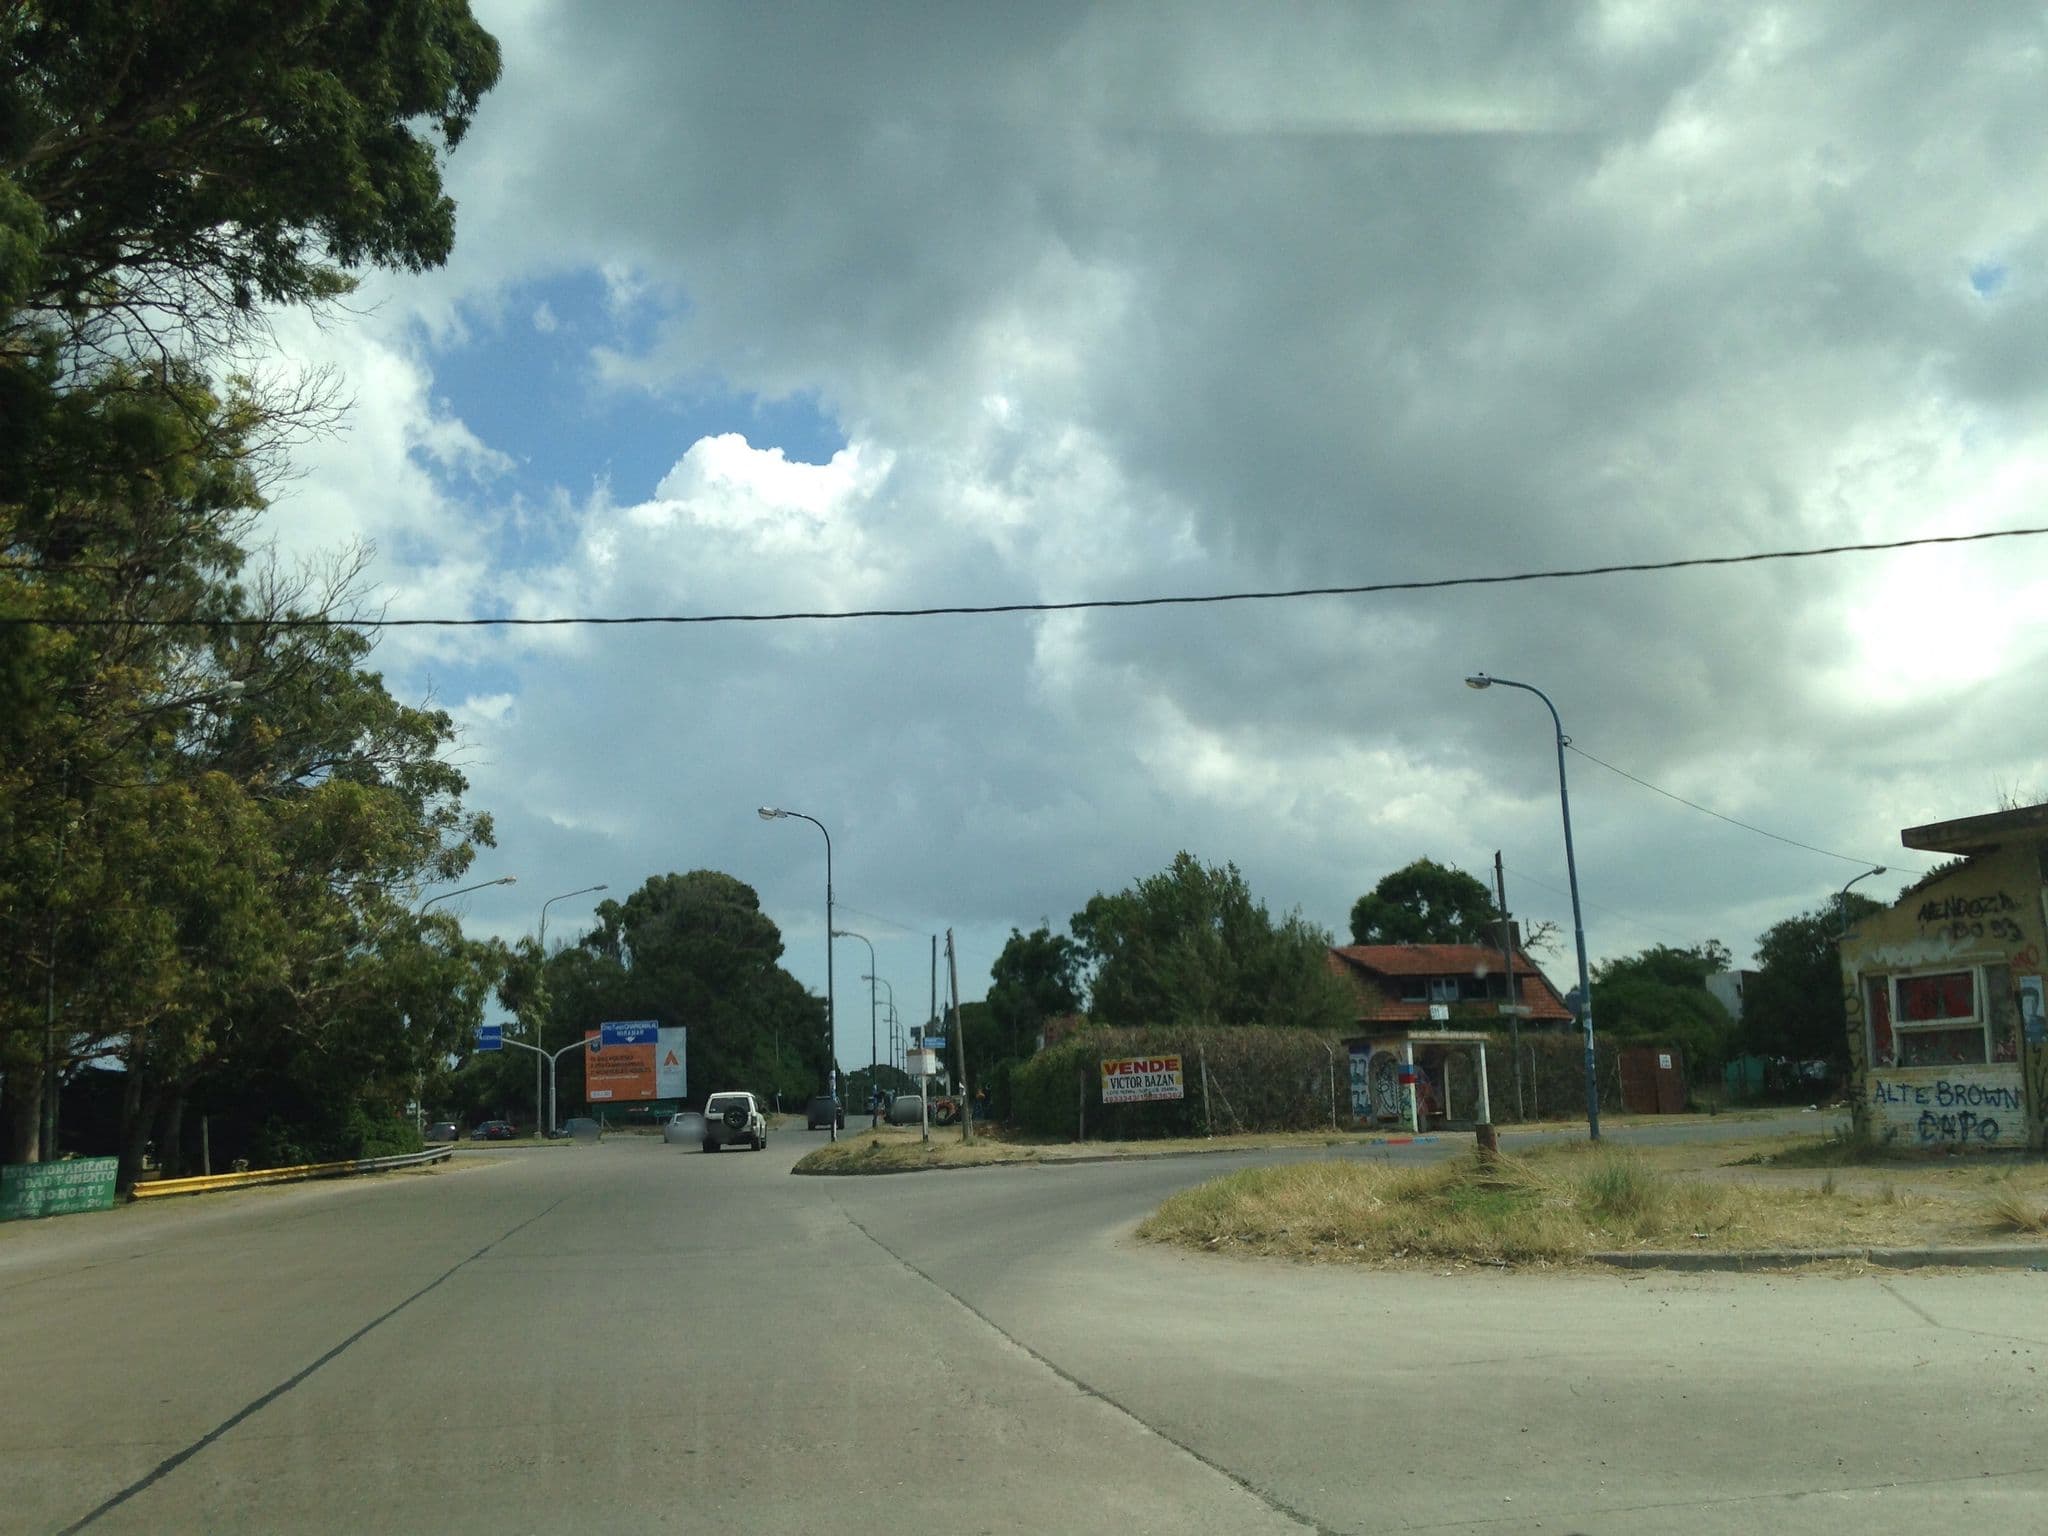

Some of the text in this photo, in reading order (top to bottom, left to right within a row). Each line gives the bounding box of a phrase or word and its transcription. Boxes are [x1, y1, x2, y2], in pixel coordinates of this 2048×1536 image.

[1103, 1058, 1179, 1075] VENDE
[1110, 1073, 1175, 1089] VICTOR BAZAN
[1873, 1079, 2020, 1109] ALTE BROWN
